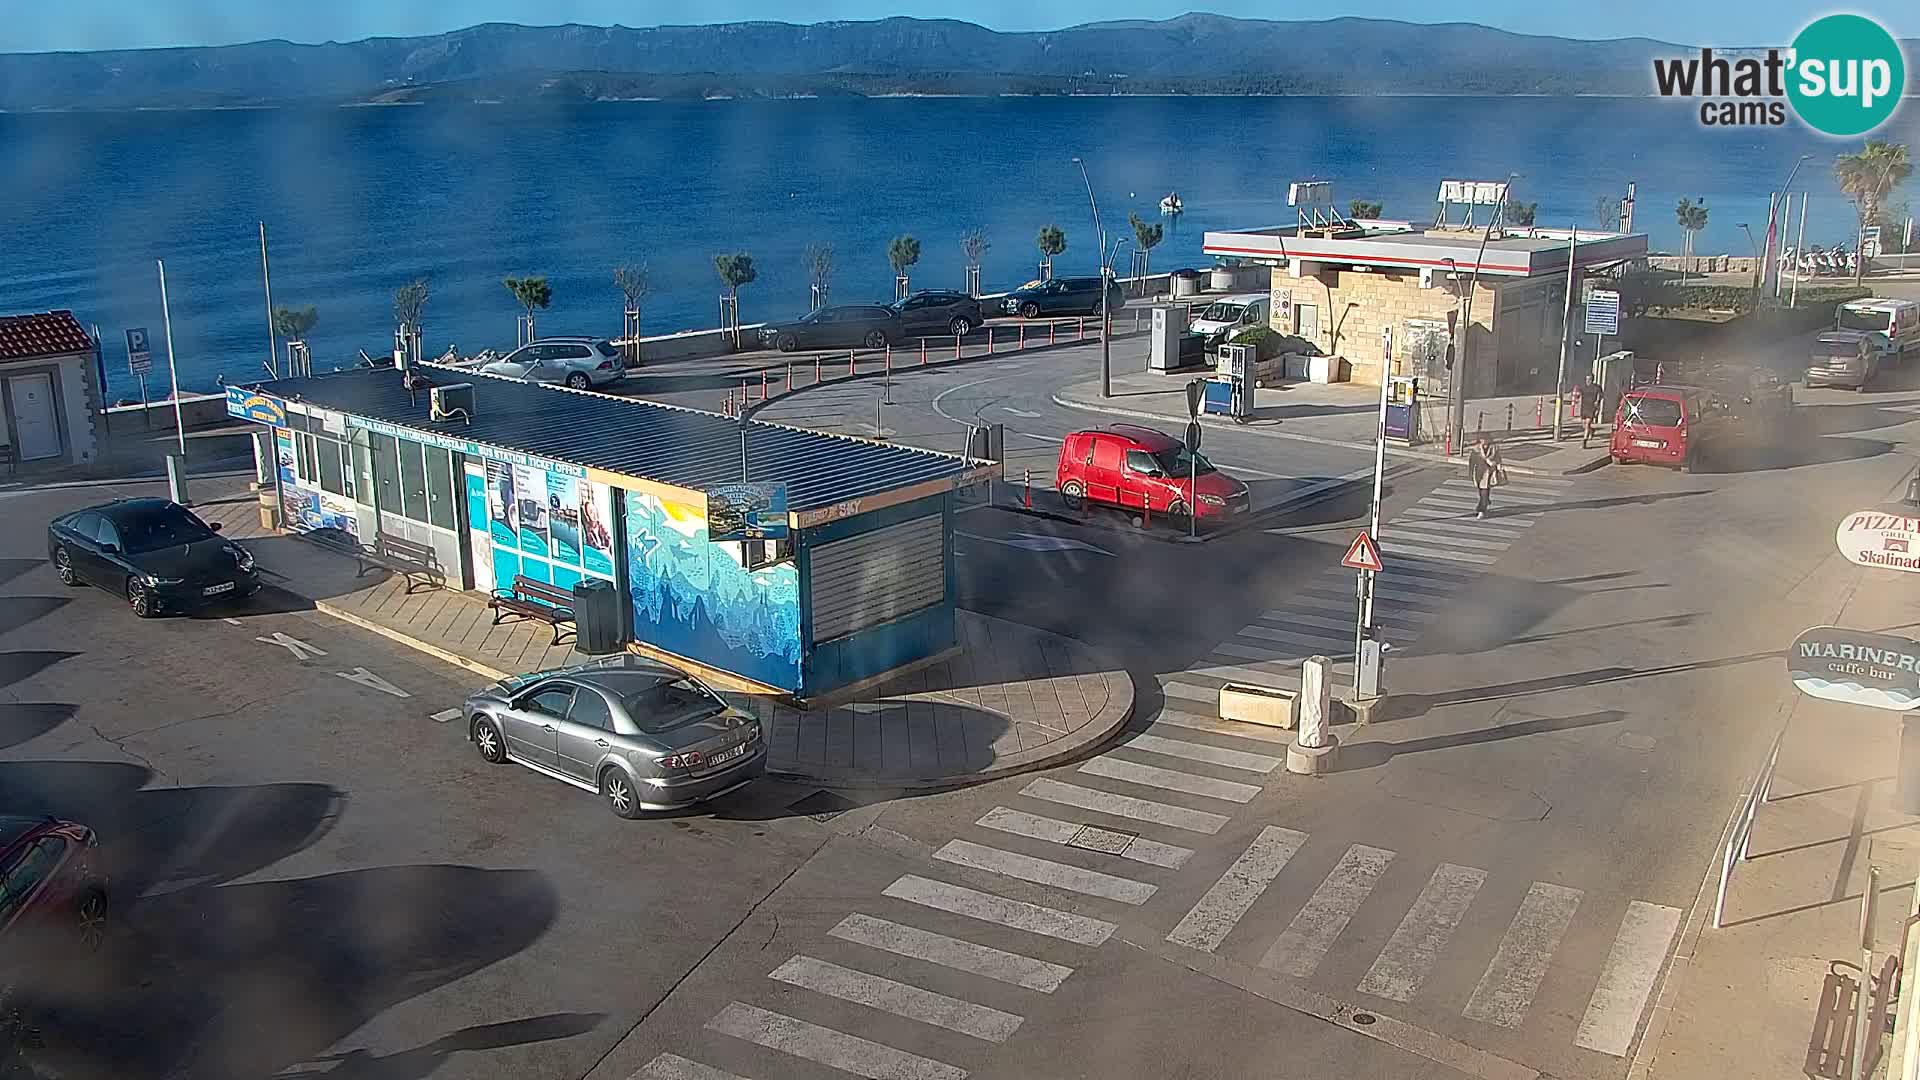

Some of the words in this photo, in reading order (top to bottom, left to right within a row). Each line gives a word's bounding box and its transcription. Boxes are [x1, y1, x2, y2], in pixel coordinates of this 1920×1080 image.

[131, 331, 144, 350] P
[478, 445, 494, 458] BUS
[495, 450, 527, 465] STATION
[528, 456, 554, 472] TICKET
[556, 462, 582, 477] OFFICE
[1828, 661, 1865, 676] caffe
[1869, 665, 1896, 680] bar
